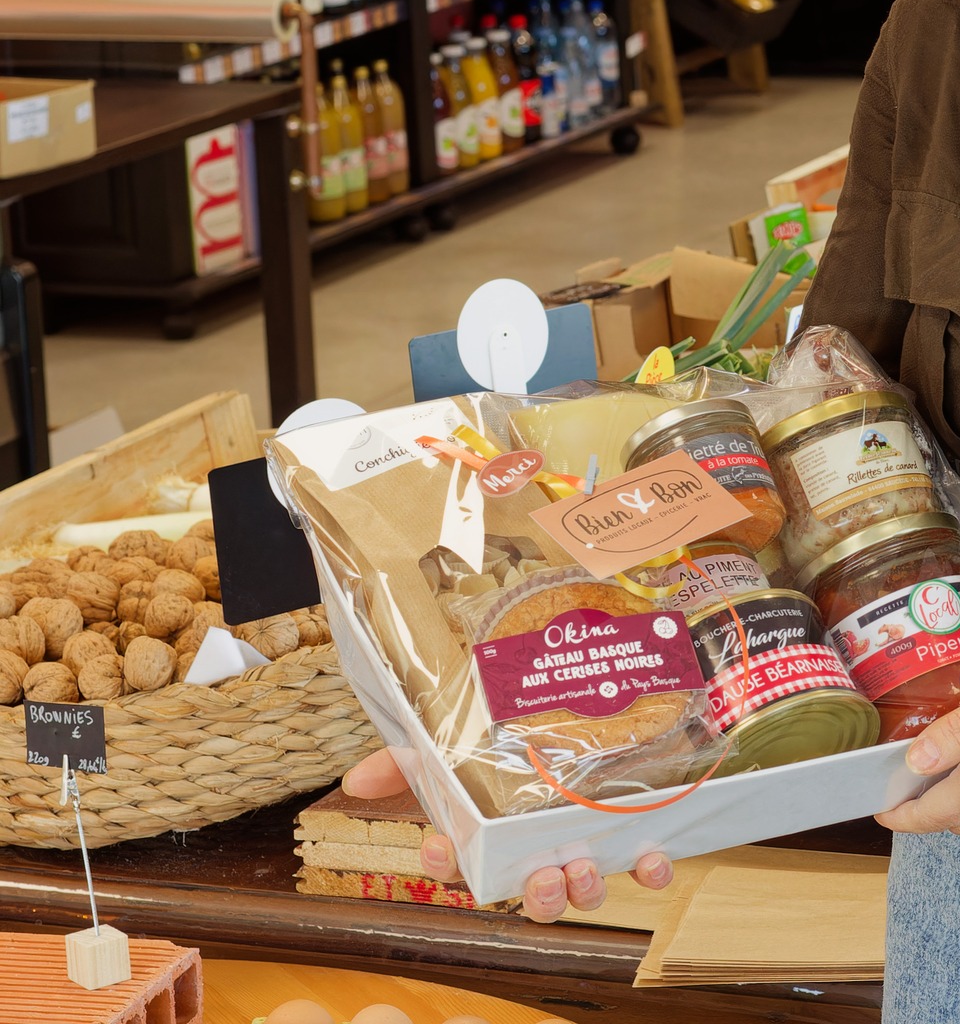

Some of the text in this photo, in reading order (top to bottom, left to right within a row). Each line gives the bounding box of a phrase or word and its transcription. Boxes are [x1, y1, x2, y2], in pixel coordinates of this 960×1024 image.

[688, 440, 724, 460] ietté
[729, 439, 748, 452] de
[716, 458, 726, 467] la
[728, 454, 759, 465] tomate
[481, 455, 536, 493] Merci
[847, 468, 882, 484] Rillettes
[884, 463, 894, 472] de
[896, 460, 918, 470] canard
[574, 506, 634, 536] Bien
[650, 478, 703, 504] Bon
[596, 528, 628, 544] PRODUITS
[629, 518, 653, 531] LOCAUX
[694, 492, 712, 503] VRAC
[680, 560, 757, 582] AU PIMENT
[876, 600, 904, 616] RECETTE
[919, 589, 960, 629] Local
[544, 622, 620, 648] Okina
[694, 608, 804, 648] BOUCHERE-CHARCUTERIE
[533, 640, 644, 670] GÂTEAU BASQUE
[708, 625, 806, 674] Lahargue
[890, 641, 913, 655] 400g
[522, 653, 664, 688] AUX CERISES NOIRES
[766, 658, 845, 682] BÉARNAISE
[514, 675, 681, 709] Biscuiterie artisanale du Pays Basque
[709, 672, 765, 714] DAUBE
